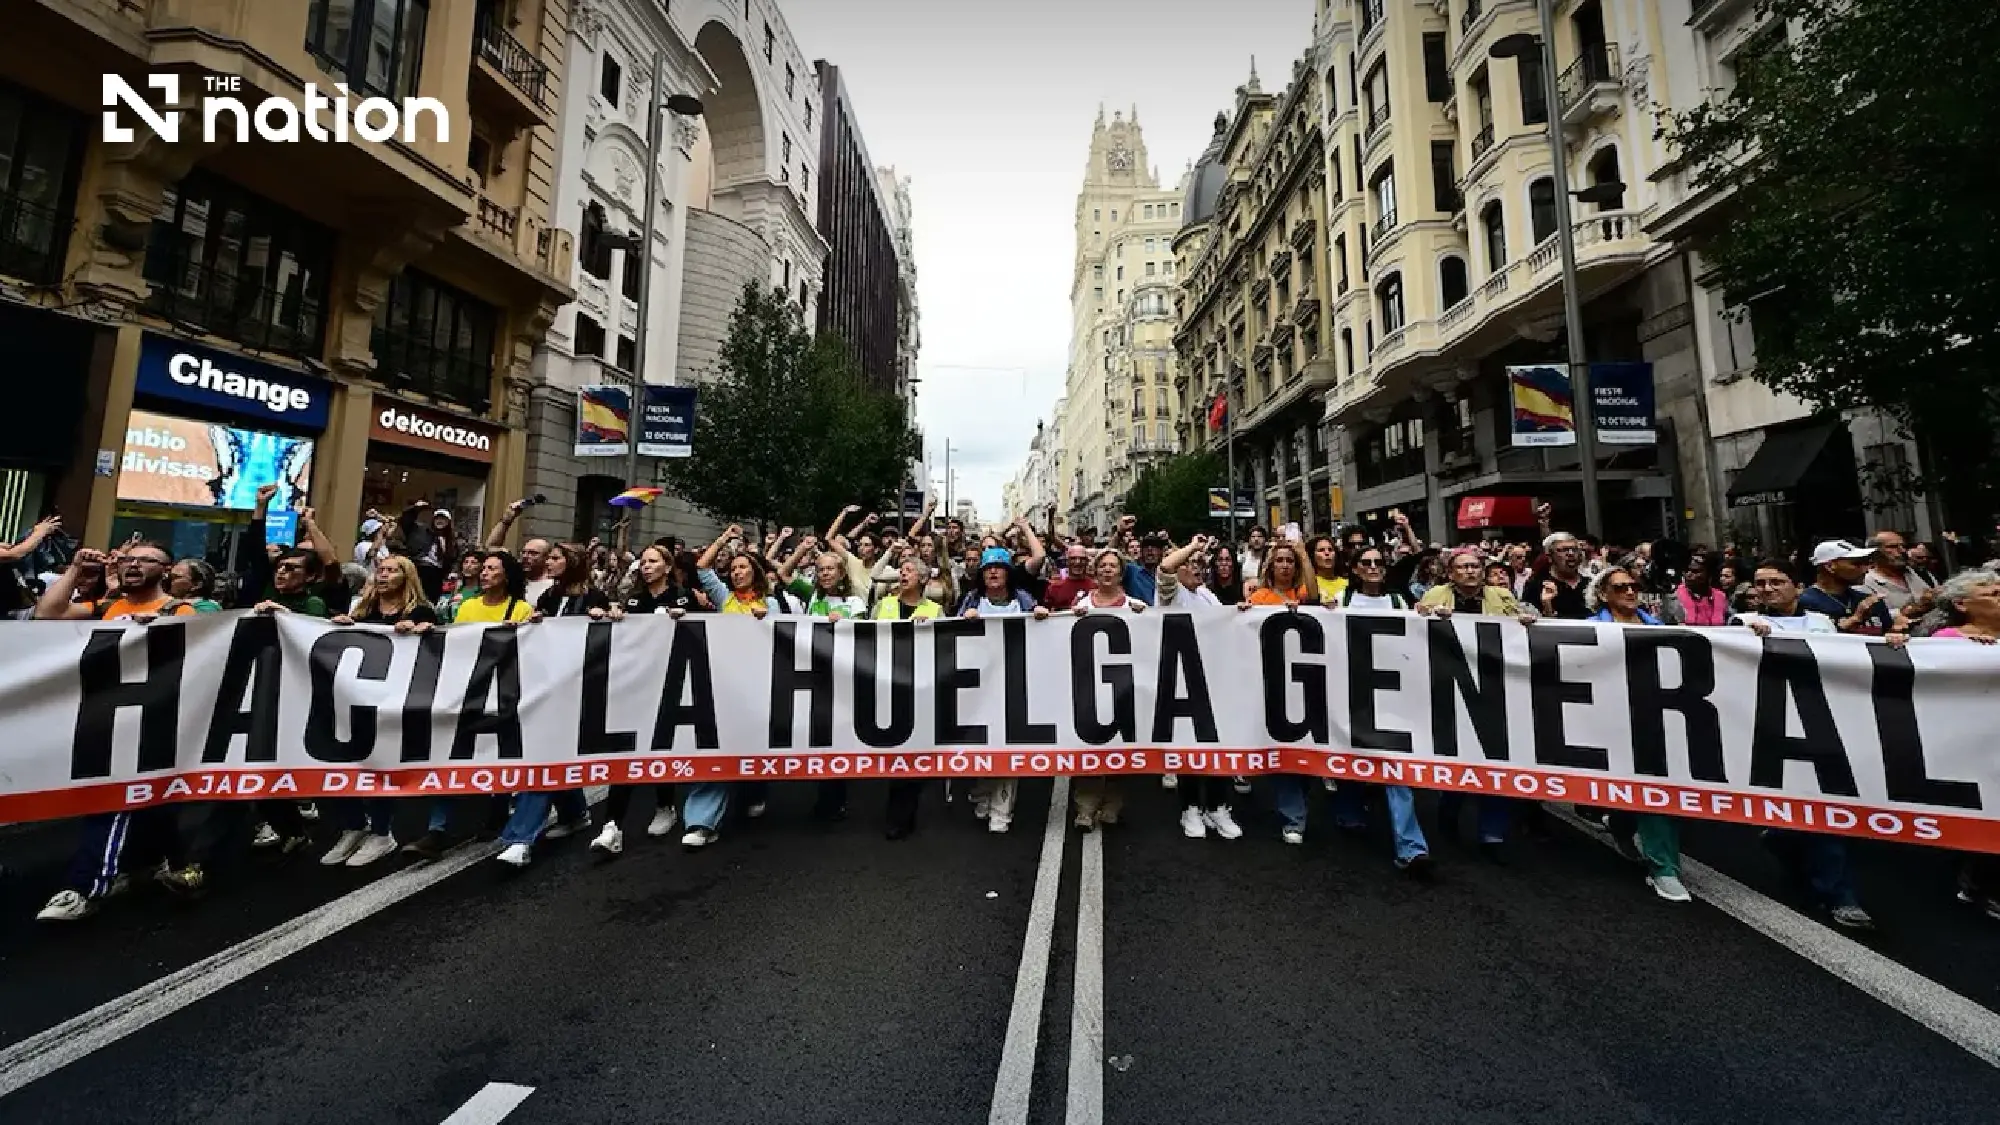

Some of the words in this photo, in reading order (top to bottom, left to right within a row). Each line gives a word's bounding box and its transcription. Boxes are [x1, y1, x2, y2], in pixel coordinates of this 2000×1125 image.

[168, 353, 310, 412] Change
[379, 408, 490, 451] dekorazon
[71, 616, 524, 780] HACIA
[577, 621, 720, 756] LA
[768, 612, 1220, 749] HUELGA
[1259, 612, 1983, 811] GENERAL
[125, 772, 299, 804] BAJADA
[322, 772, 402, 793] DEL
[419, 764, 610, 791] ALQUILER
[628, 759, 695, 778] 50%
[739, 752, 993, 776] EXPROPIACIÓN
[1010, 752, 1148, 772] FONDOS
[1164, 750, 1282, 770] BUITRE
[1327, 755, 1568, 797] CONTRATOS
[1590, 781, 1944, 841] INDEFINIDOS
